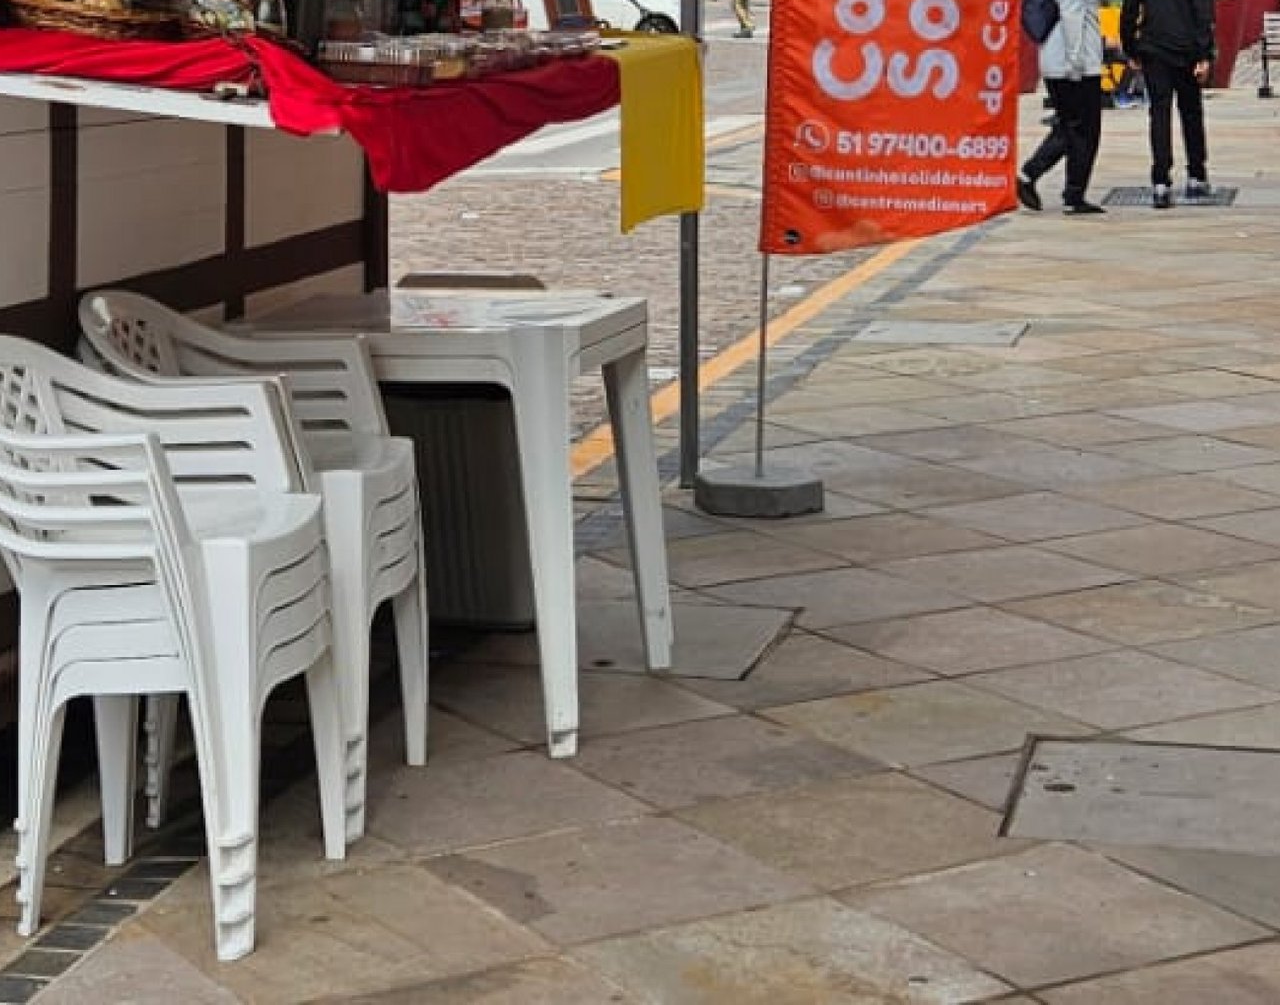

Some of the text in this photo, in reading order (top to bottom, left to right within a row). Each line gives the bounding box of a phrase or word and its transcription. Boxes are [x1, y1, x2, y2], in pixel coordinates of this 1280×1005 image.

[980, 67, 1003, 116] do
[836, 130, 1009, 161] 51 97400-6899
